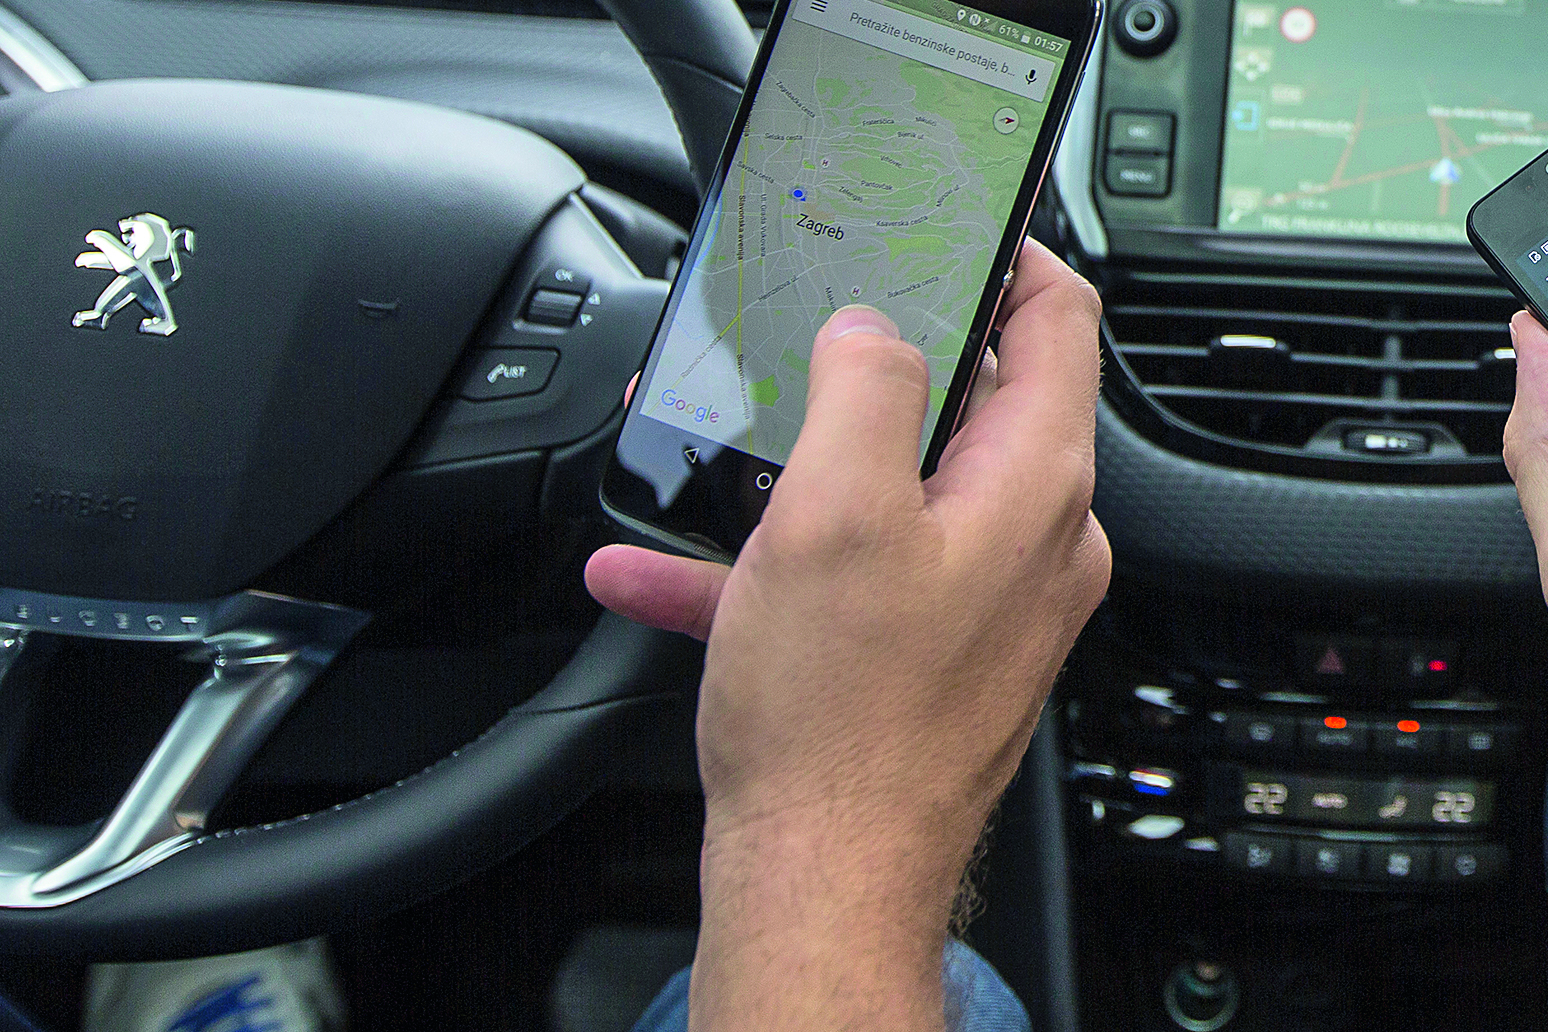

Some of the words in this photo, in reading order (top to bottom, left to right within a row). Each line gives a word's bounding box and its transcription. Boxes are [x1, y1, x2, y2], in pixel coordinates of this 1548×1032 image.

[850, 11, 901, 38] Pretražite
[902, 24, 956, 56] benzinske
[956, 48, 1000, 73] postaje,
[998, 24, 1020, 39] 61%
[1034, 36, 1064, 52] 01:57
[796, 213, 845, 241] Zagreb
[661, 388, 720, 423] Google
[1244, 782, 1288, 815] 22
[1431, 791, 1475, 823] 22
